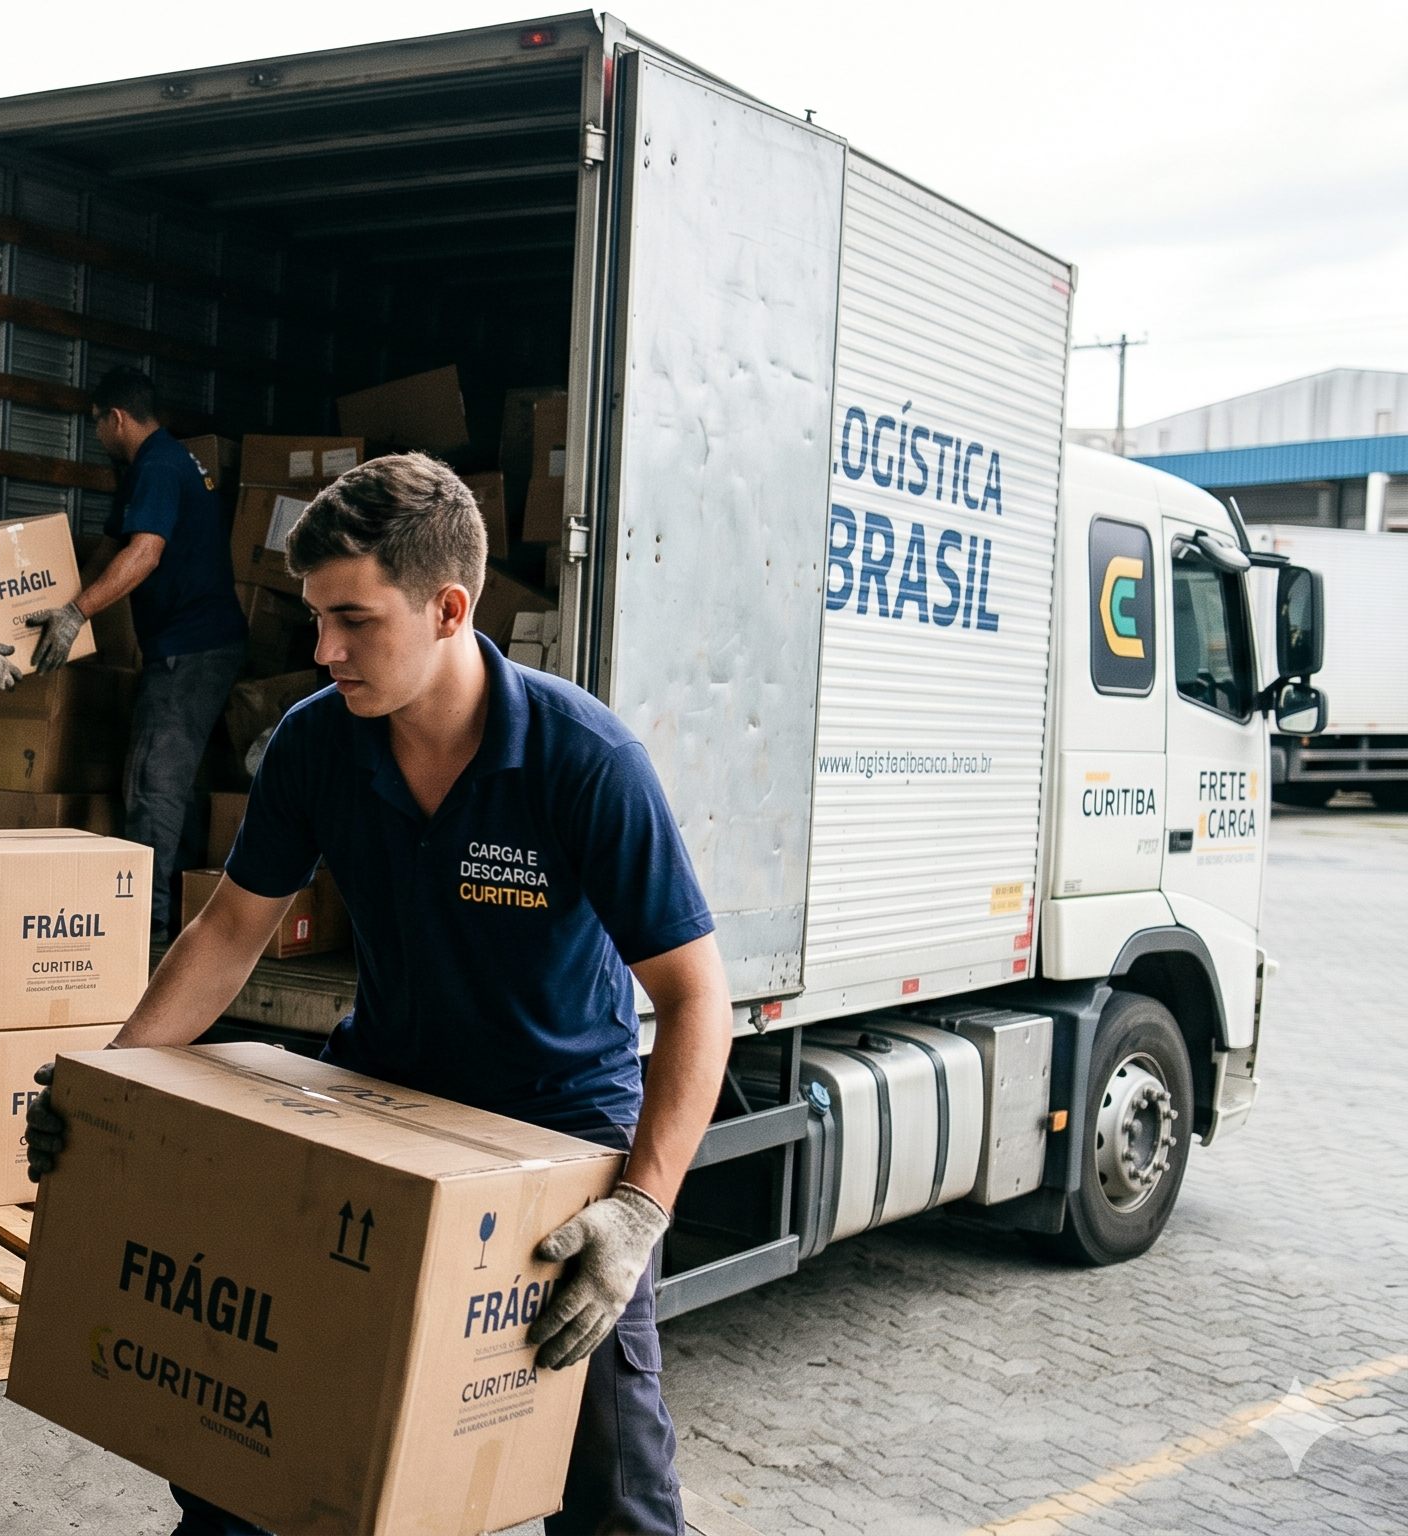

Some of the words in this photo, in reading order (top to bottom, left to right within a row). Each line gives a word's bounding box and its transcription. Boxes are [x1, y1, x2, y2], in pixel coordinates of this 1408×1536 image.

[833, 400, 1002, 516] OGÍSTICA
[825, 503, 999, 632] BRASIL
[1199, 771, 1247, 801] FRETE
[1082, 788, 1156, 817] CURITIBA
[1208, 808, 1257, 839] CARGA
[468, 842, 524, 864] CARGA
[527, 850, 538, 866] E
[460, 861, 549, 887] DESCARGA
[460, 882, 548, 908] CURITIBA
[22, 907, 106, 939] FRÁGIL
[32, 960, 93, 973] CURITIBA
[119, 1240, 279, 1353] FRÁGIL
[464, 1274, 558, 1338] FRÁGI
[113, 1338, 273, 1439] CURITIBA
[461, 1365, 538, 1403] CURITIBA
